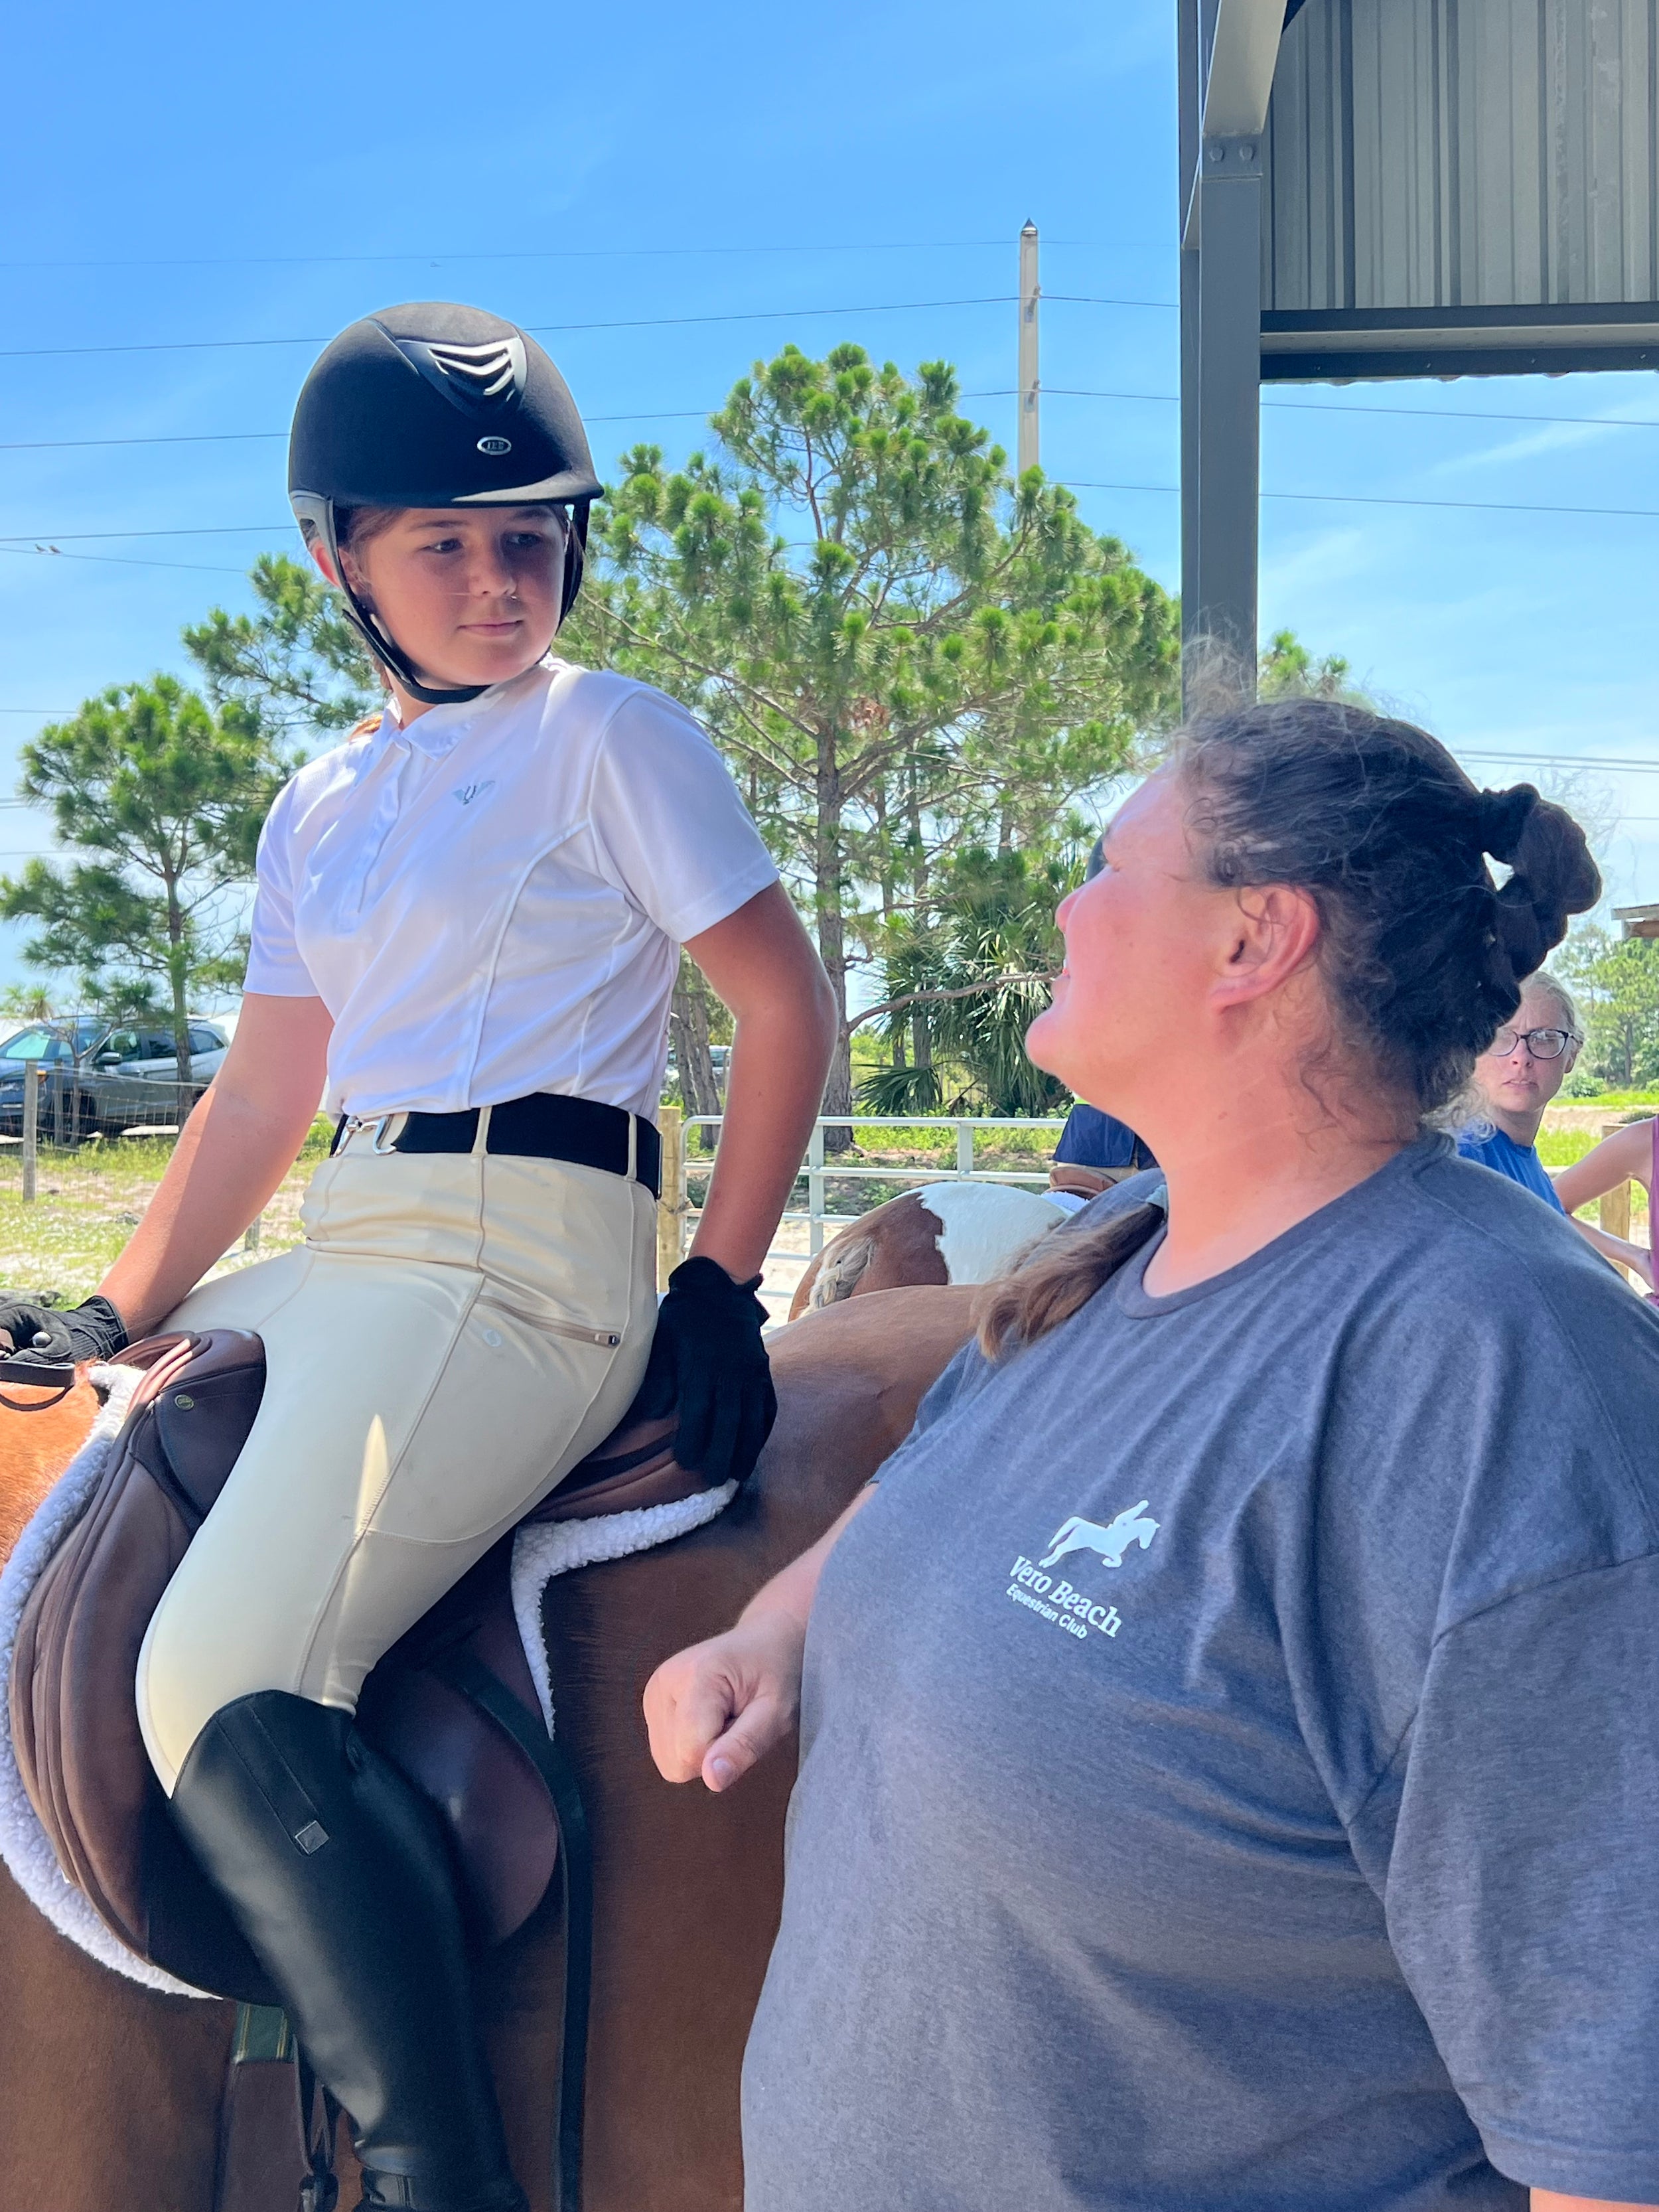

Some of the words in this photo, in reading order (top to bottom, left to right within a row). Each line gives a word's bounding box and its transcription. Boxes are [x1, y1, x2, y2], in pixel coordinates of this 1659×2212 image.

[1006, 1583, 1058, 1621] Equestrian
[1058, 1614, 1088, 1639] Club
[1009, 1555, 1052, 1593] Vero
[1048, 1580, 1121, 1637] Beach
